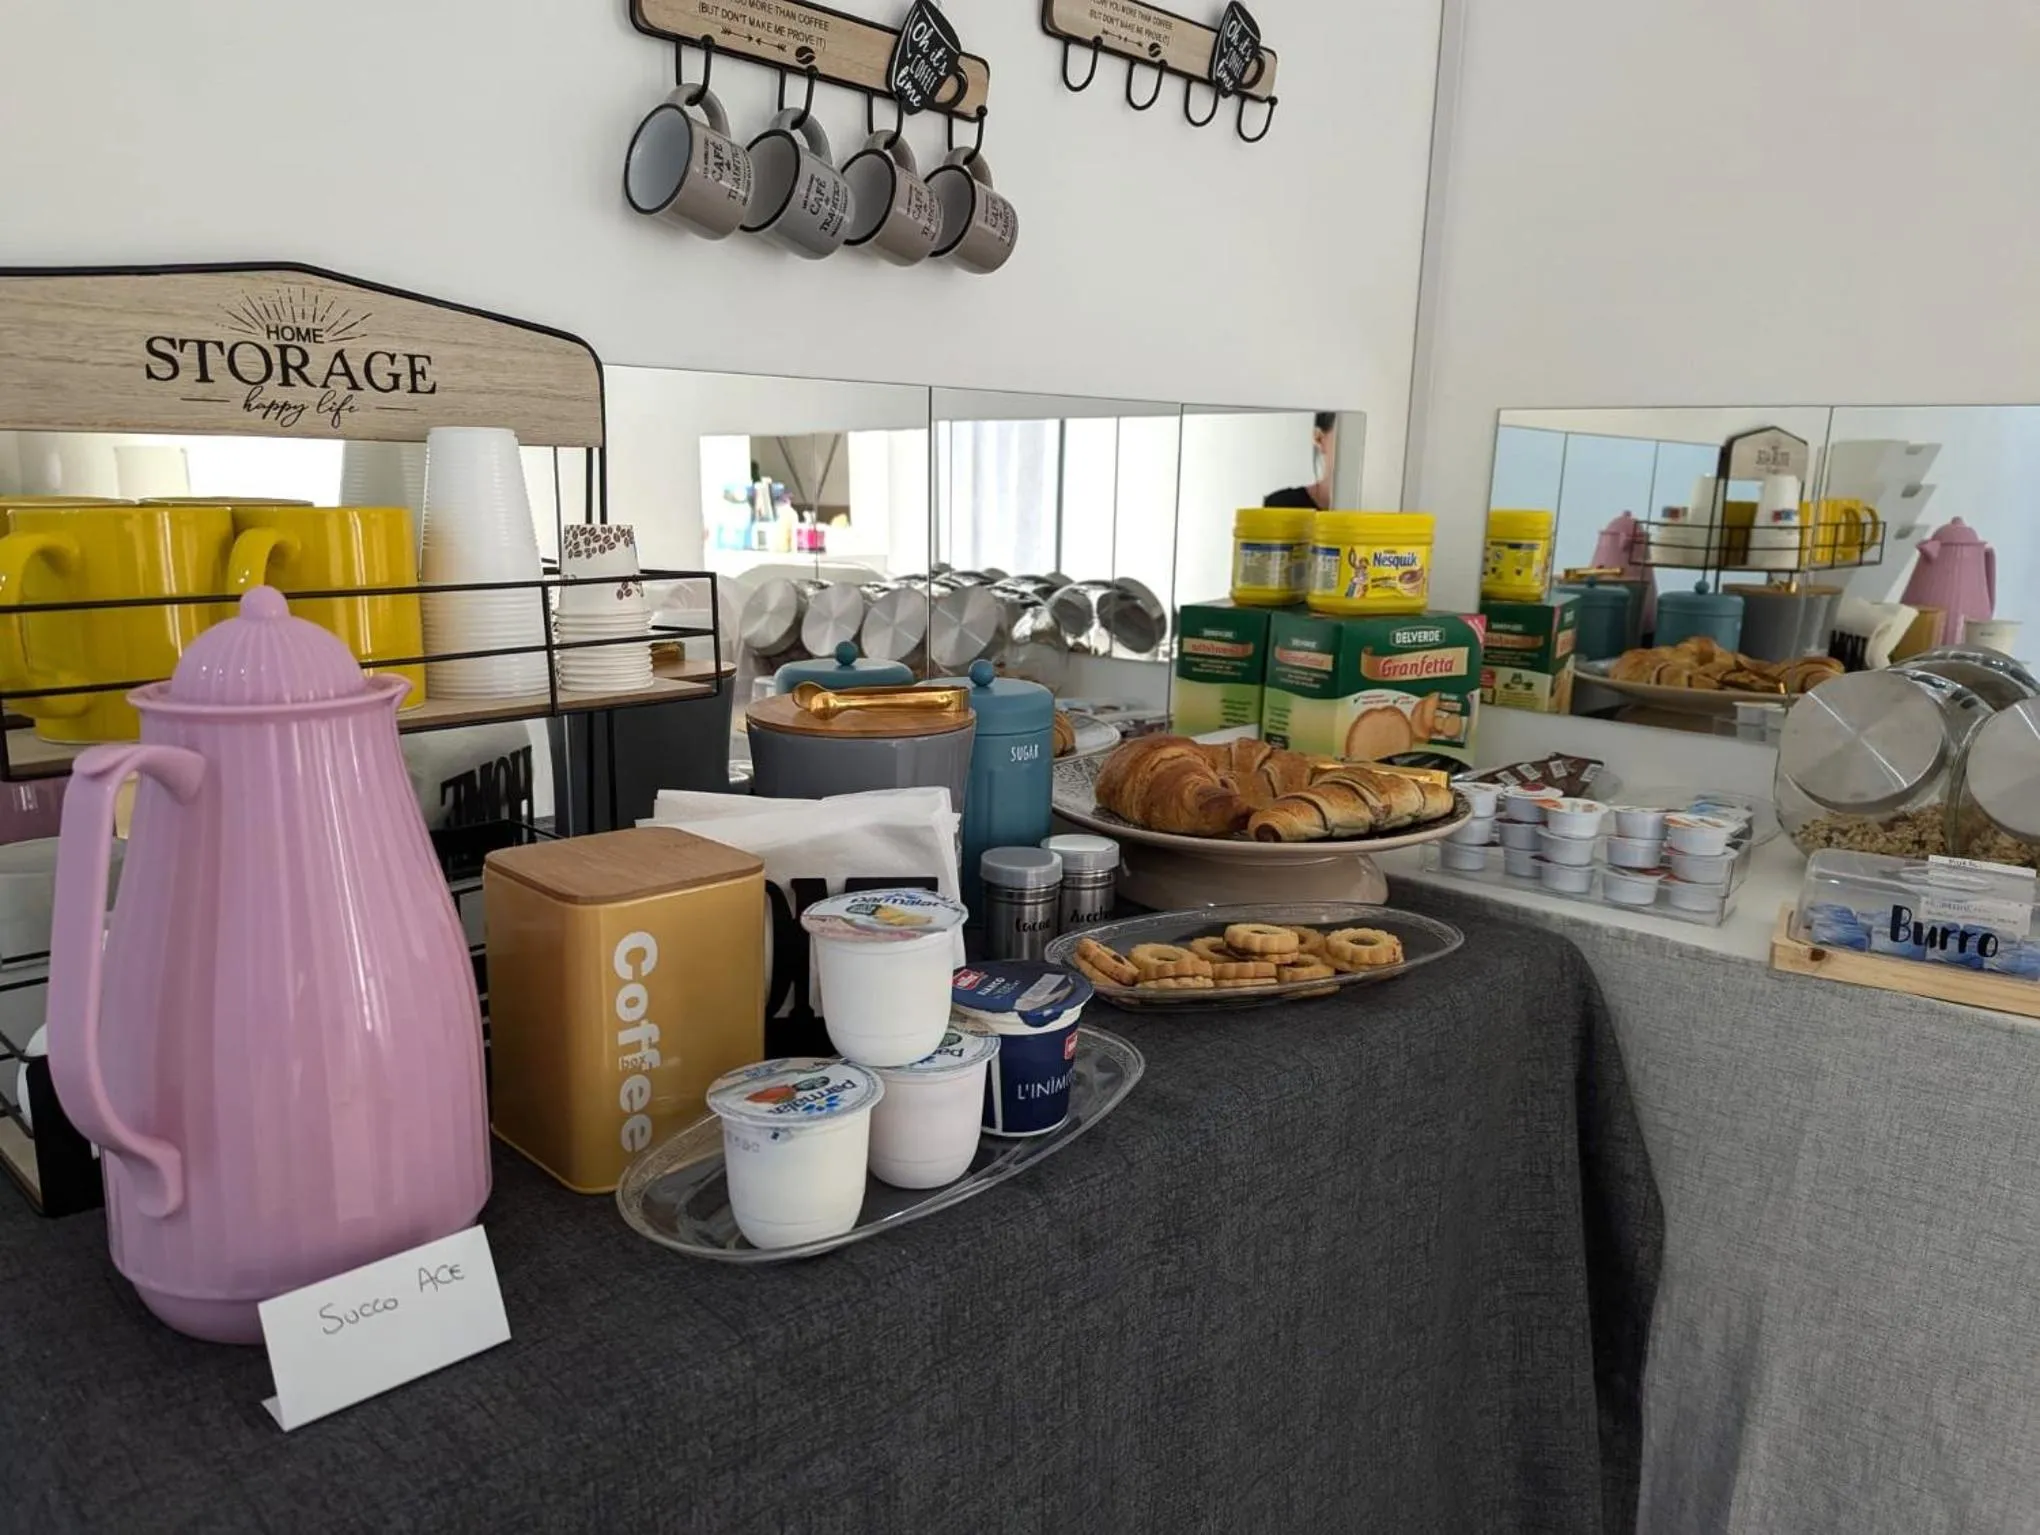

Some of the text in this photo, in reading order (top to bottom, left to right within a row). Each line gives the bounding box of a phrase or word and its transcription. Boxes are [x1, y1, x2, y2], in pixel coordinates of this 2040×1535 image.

[721, 8, 747, 25] DON'T
[748, 16, 773, 33] MAKE
[774, 23, 786, 36] ME
[787, 28, 815, 45] PROVE
[775, 6, 797, 20] THAN
[799, 13, 830, 31] COFFEE
[912, 21, 948, 76] Oh it's
[896, 65, 922, 107] time
[910, 54, 938, 94] COFFEE
[710, 141, 724, 182] CAFÉ
[810, 177, 826, 216] CAFÉ
[265, 323, 325, 344] HOME
[145, 335, 437, 395] STORAGE
[242, 385, 360, 429] happy life
[1373, 552, 1417, 570] Nesquik
[1395, 630, 1442, 644] DELVERDE
[1381, 655, 1455, 678] Granfetta
[1010, 744, 1039, 762] SUGAR
[1890, 905, 1999, 958] Burro
[613, 931, 661, 1152] Coffee
[621, 1054, 648, 1070] box
[768, 1079, 856, 1114] parmalat
[319, 1264, 465, 1335] Succo ACE
